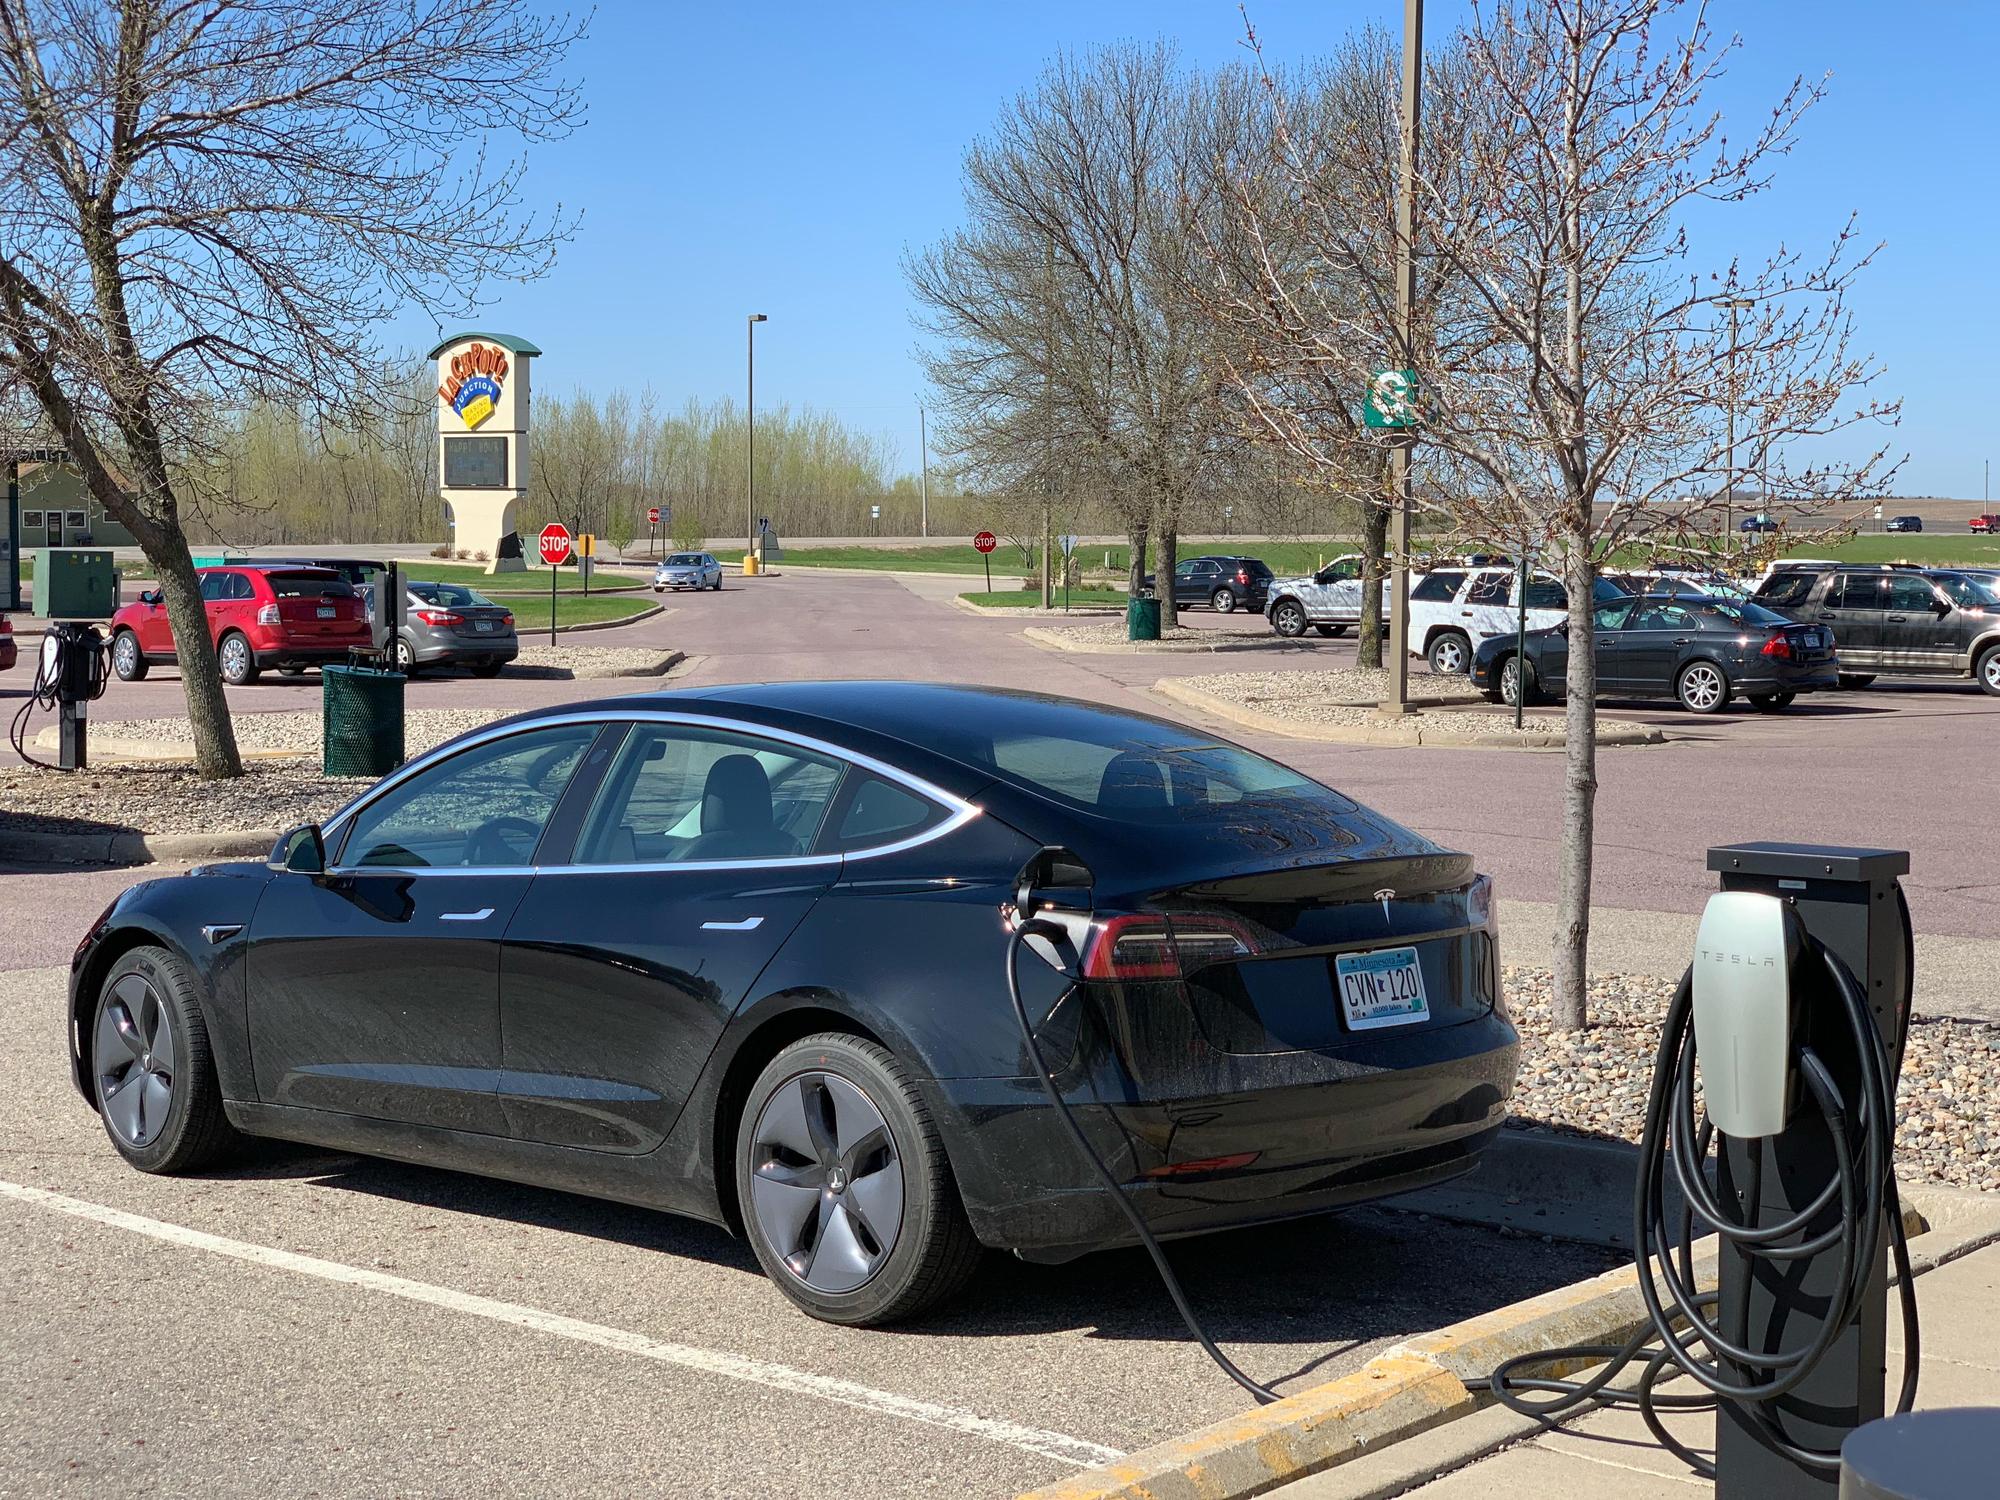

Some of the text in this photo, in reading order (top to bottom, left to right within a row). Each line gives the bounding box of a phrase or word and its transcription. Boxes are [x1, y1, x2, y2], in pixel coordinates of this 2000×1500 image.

[456, 381, 493, 410] JUNCTION
[465, 398, 488, 417] CASINO
[468, 407, 489, 423] HOTEL
[541, 536, 569, 552] STOP
[975, 537, 995, 548] STOP
[1358, 957, 1396, 969] Minnesota
[1701, 950, 1774, 967] TESLA
[1344, 967, 1418, 1008] CVN 120
